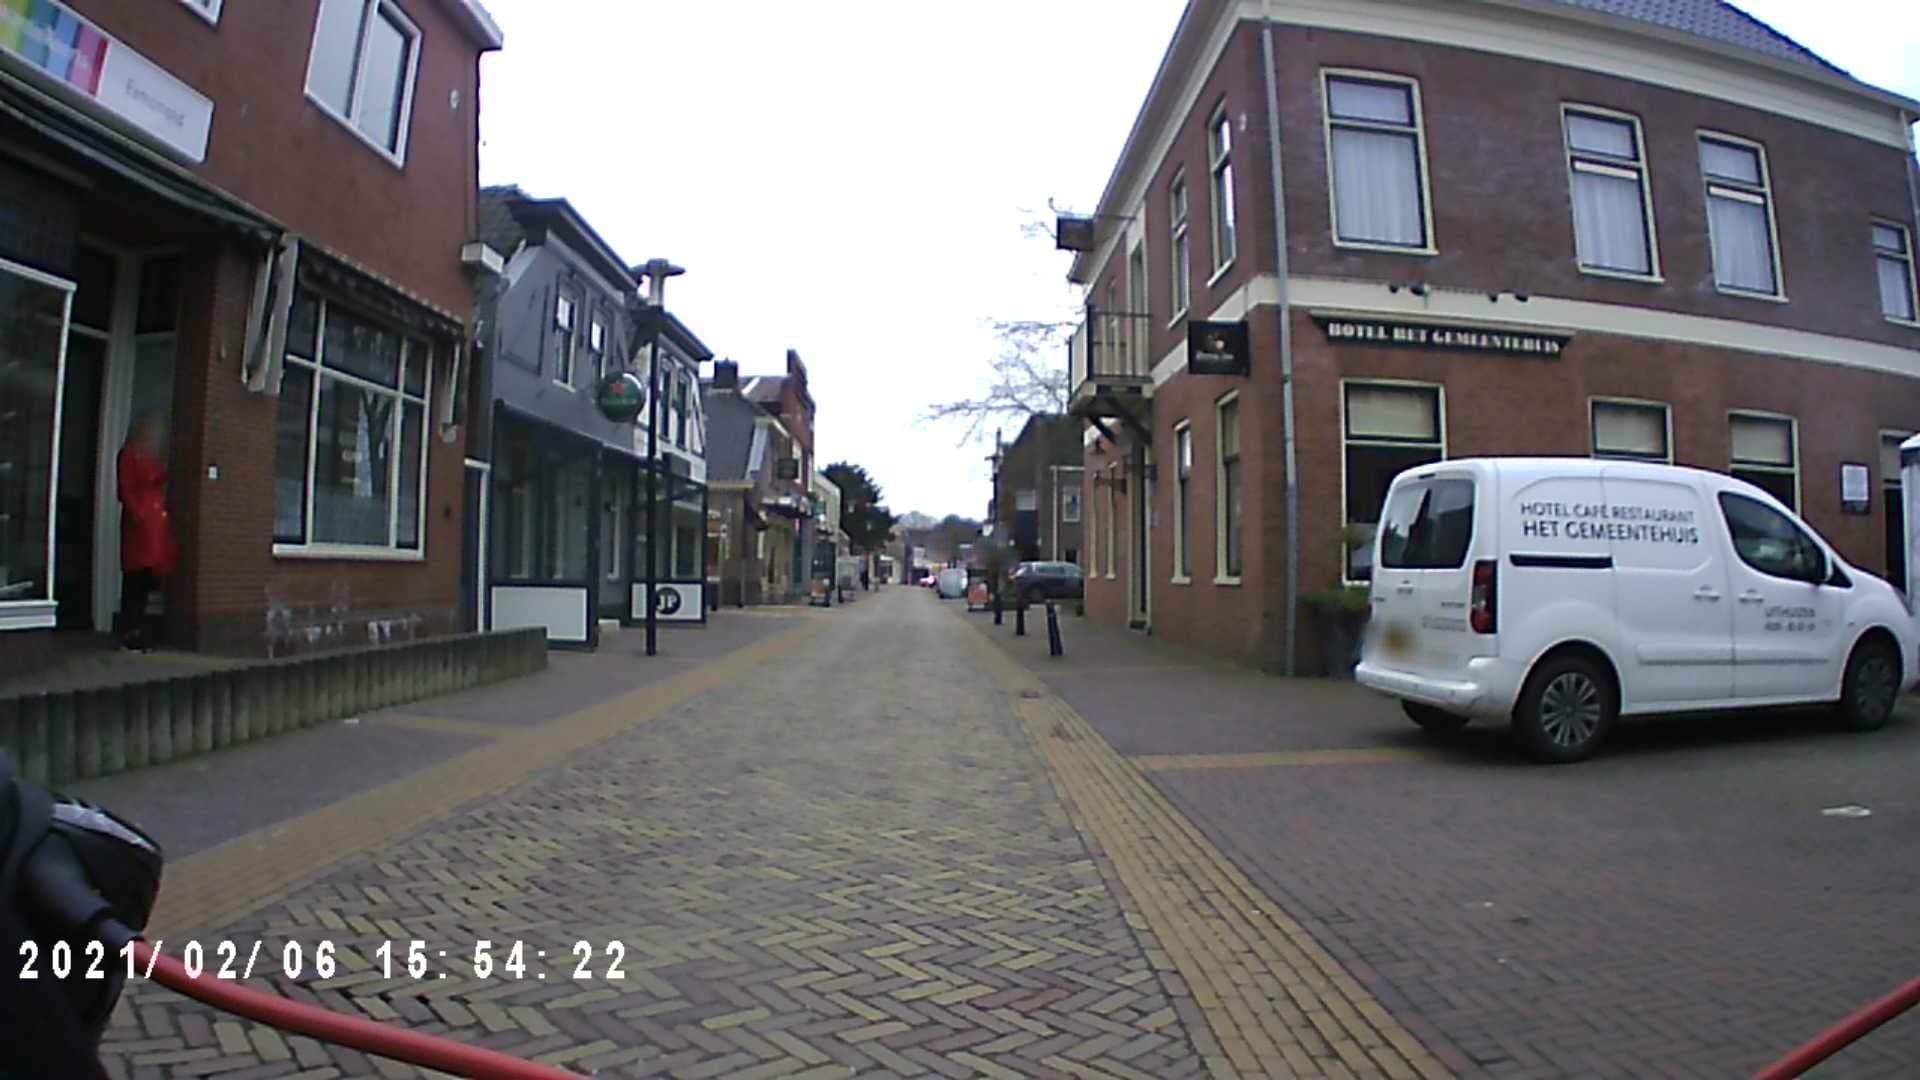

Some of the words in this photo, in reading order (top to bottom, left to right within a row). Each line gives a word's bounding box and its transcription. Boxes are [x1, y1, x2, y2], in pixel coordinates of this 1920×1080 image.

[1328, 322, 1389, 339] HOTEL
[1393, 327, 1427, 342] HET
[1432, 330, 1560, 352] GEMEENTEHUIS
[1520, 502, 1569, 517] HOTEL
[1573, 504, 1609, 519] CAFÉ
[1612, 506, 1694, 523] RESTAURANT
[1522, 521, 1559, 537] HET
[1565, 522, 1699, 544] GEMEENTEHUIS
